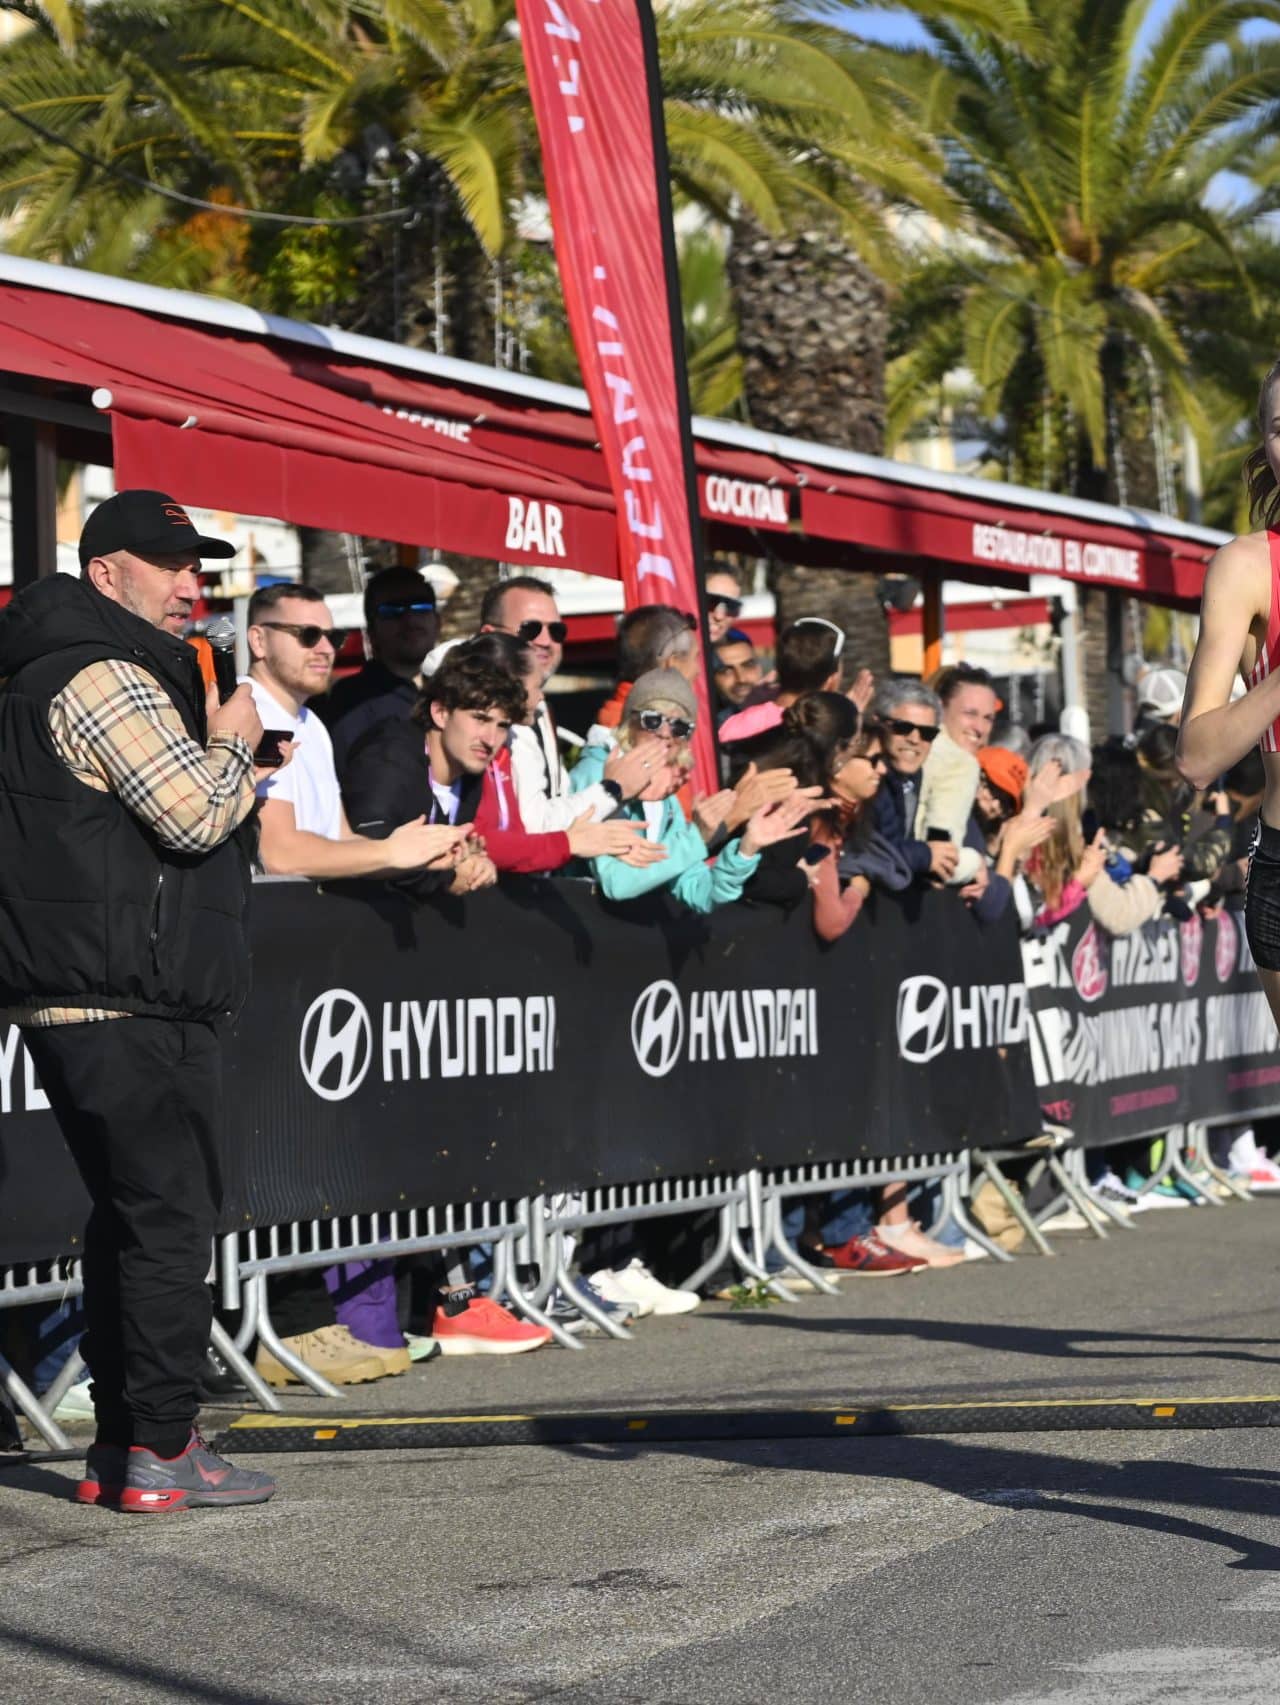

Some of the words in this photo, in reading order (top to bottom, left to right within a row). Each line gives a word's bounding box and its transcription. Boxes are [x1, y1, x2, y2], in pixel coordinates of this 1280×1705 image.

[505, 496, 567, 557] BAR
[705, 475, 789, 524] COCKTAIL
[383, 995, 556, 1082] HYUNDAI
[688, 988, 818, 1062] HYUNDAI
